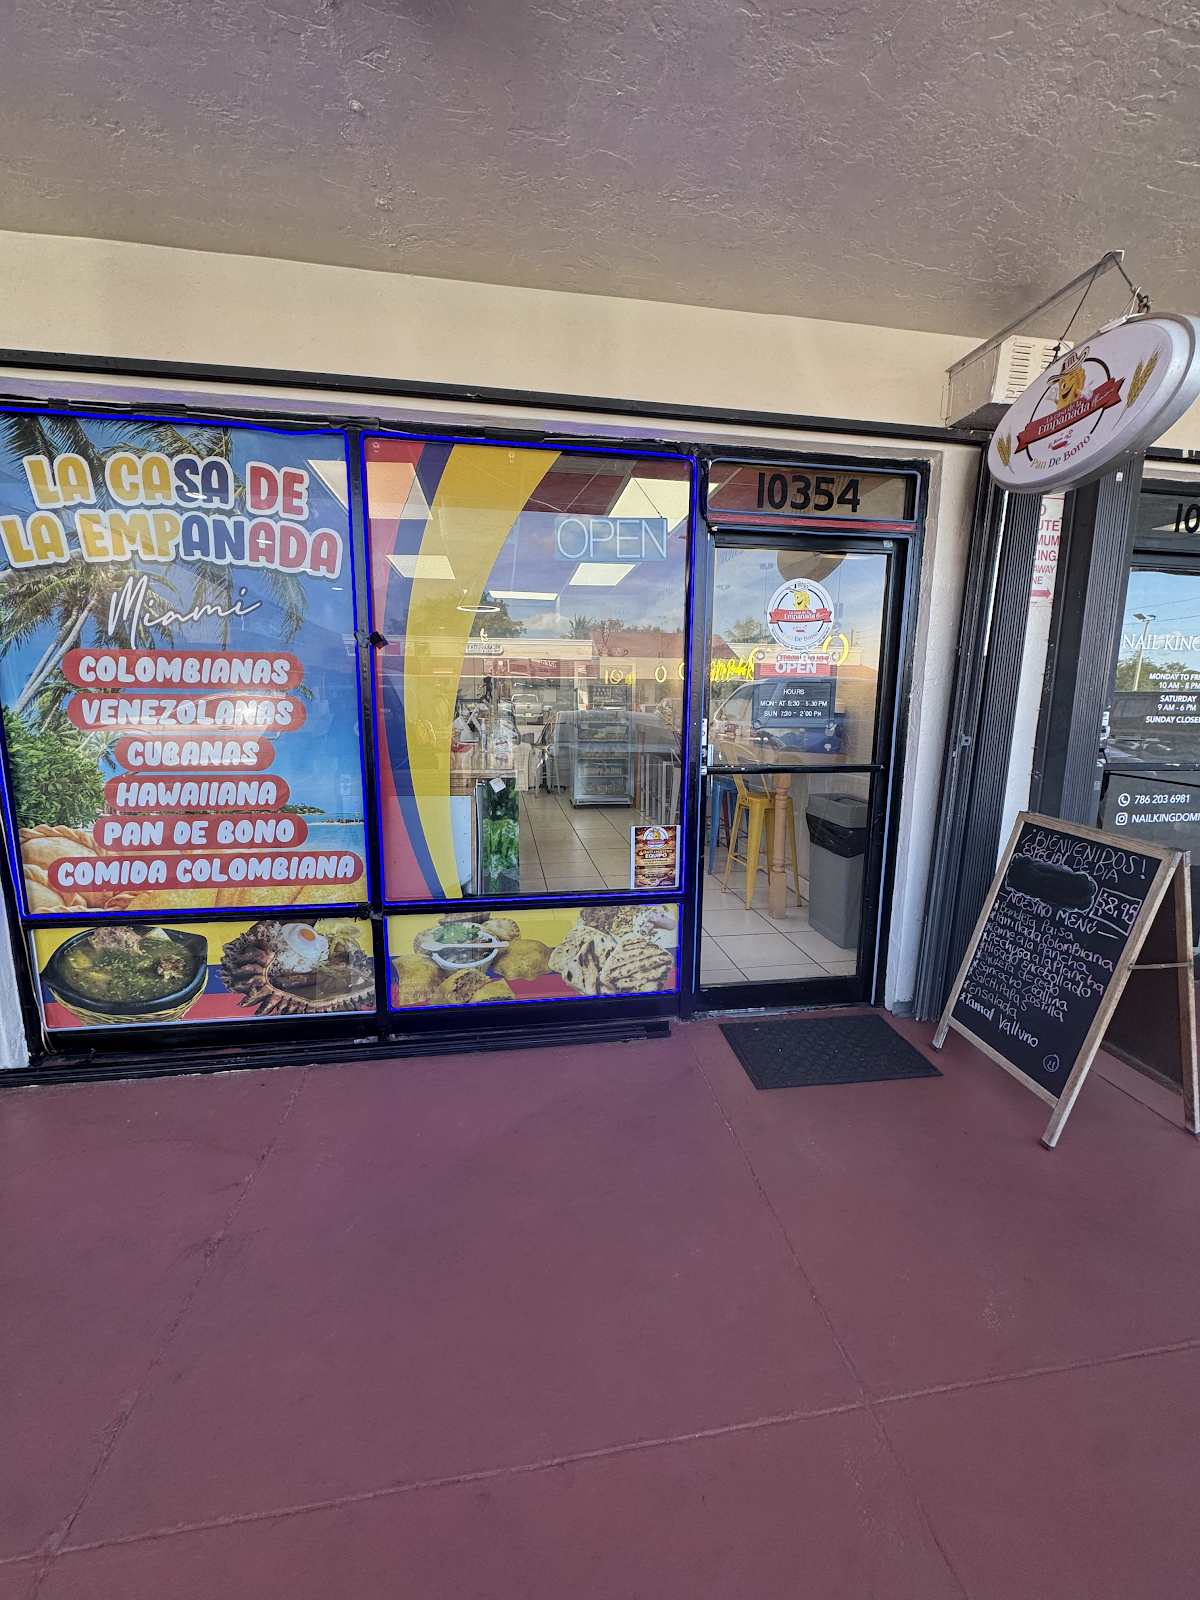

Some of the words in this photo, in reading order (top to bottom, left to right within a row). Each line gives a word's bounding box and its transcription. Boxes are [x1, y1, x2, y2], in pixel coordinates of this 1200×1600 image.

[1038, 402, 1090, 435] Empanada
[1030, 458, 1046, 469] Pan
[1048, 457, 1061, 468] De
[1063, 436, 1090, 461] Bono
[25, 455, 94, 508] LA
[106, 454, 232, 508] CASA
[247, 463, 308, 519] DE
[757, 471, 861, 513] 10354
[1, 516, 69, 567] LA
[76, 510, 342, 578] EMPANADA
[556, 517, 668, 560] OPEN
[108, 574, 262, 649] Miami
[803, 632, 819, 642] Bono
[1122, 633, 1160, 650] NAIL
[78, 655, 291, 685] COLOMBIANAS
[775, 662, 817, 674] OPEN
[81, 698, 294, 726] VENEZOLANAS
[127, 740, 260, 767] CUBANAS
[116, 781, 277, 807] HAWAIIANA
[1134, 794, 1150, 804] 786
[1152, 794, 1169, 804] 203
[1169, 794, 1191, 804] 6981
[1131, 812, 1200, 823] NAILKINGDOM
[103, 821, 163, 846] PAN
[173, 820, 209, 845] DE
[216, 818, 295, 844] BONO
[57, 860, 167, 887] COMIDA
[176, 855, 355, 883] COLOMBIANA
[1023, 842, 1070, 867] ESPECIAL
[1073, 856, 1090, 873] DE
[989, 921, 1015, 941] Carne
[1041, 919, 1074, 941] Paisa
[965, 993, 995, 1021] Tamal
[969, 982, 1018, 1020] Ensalada
